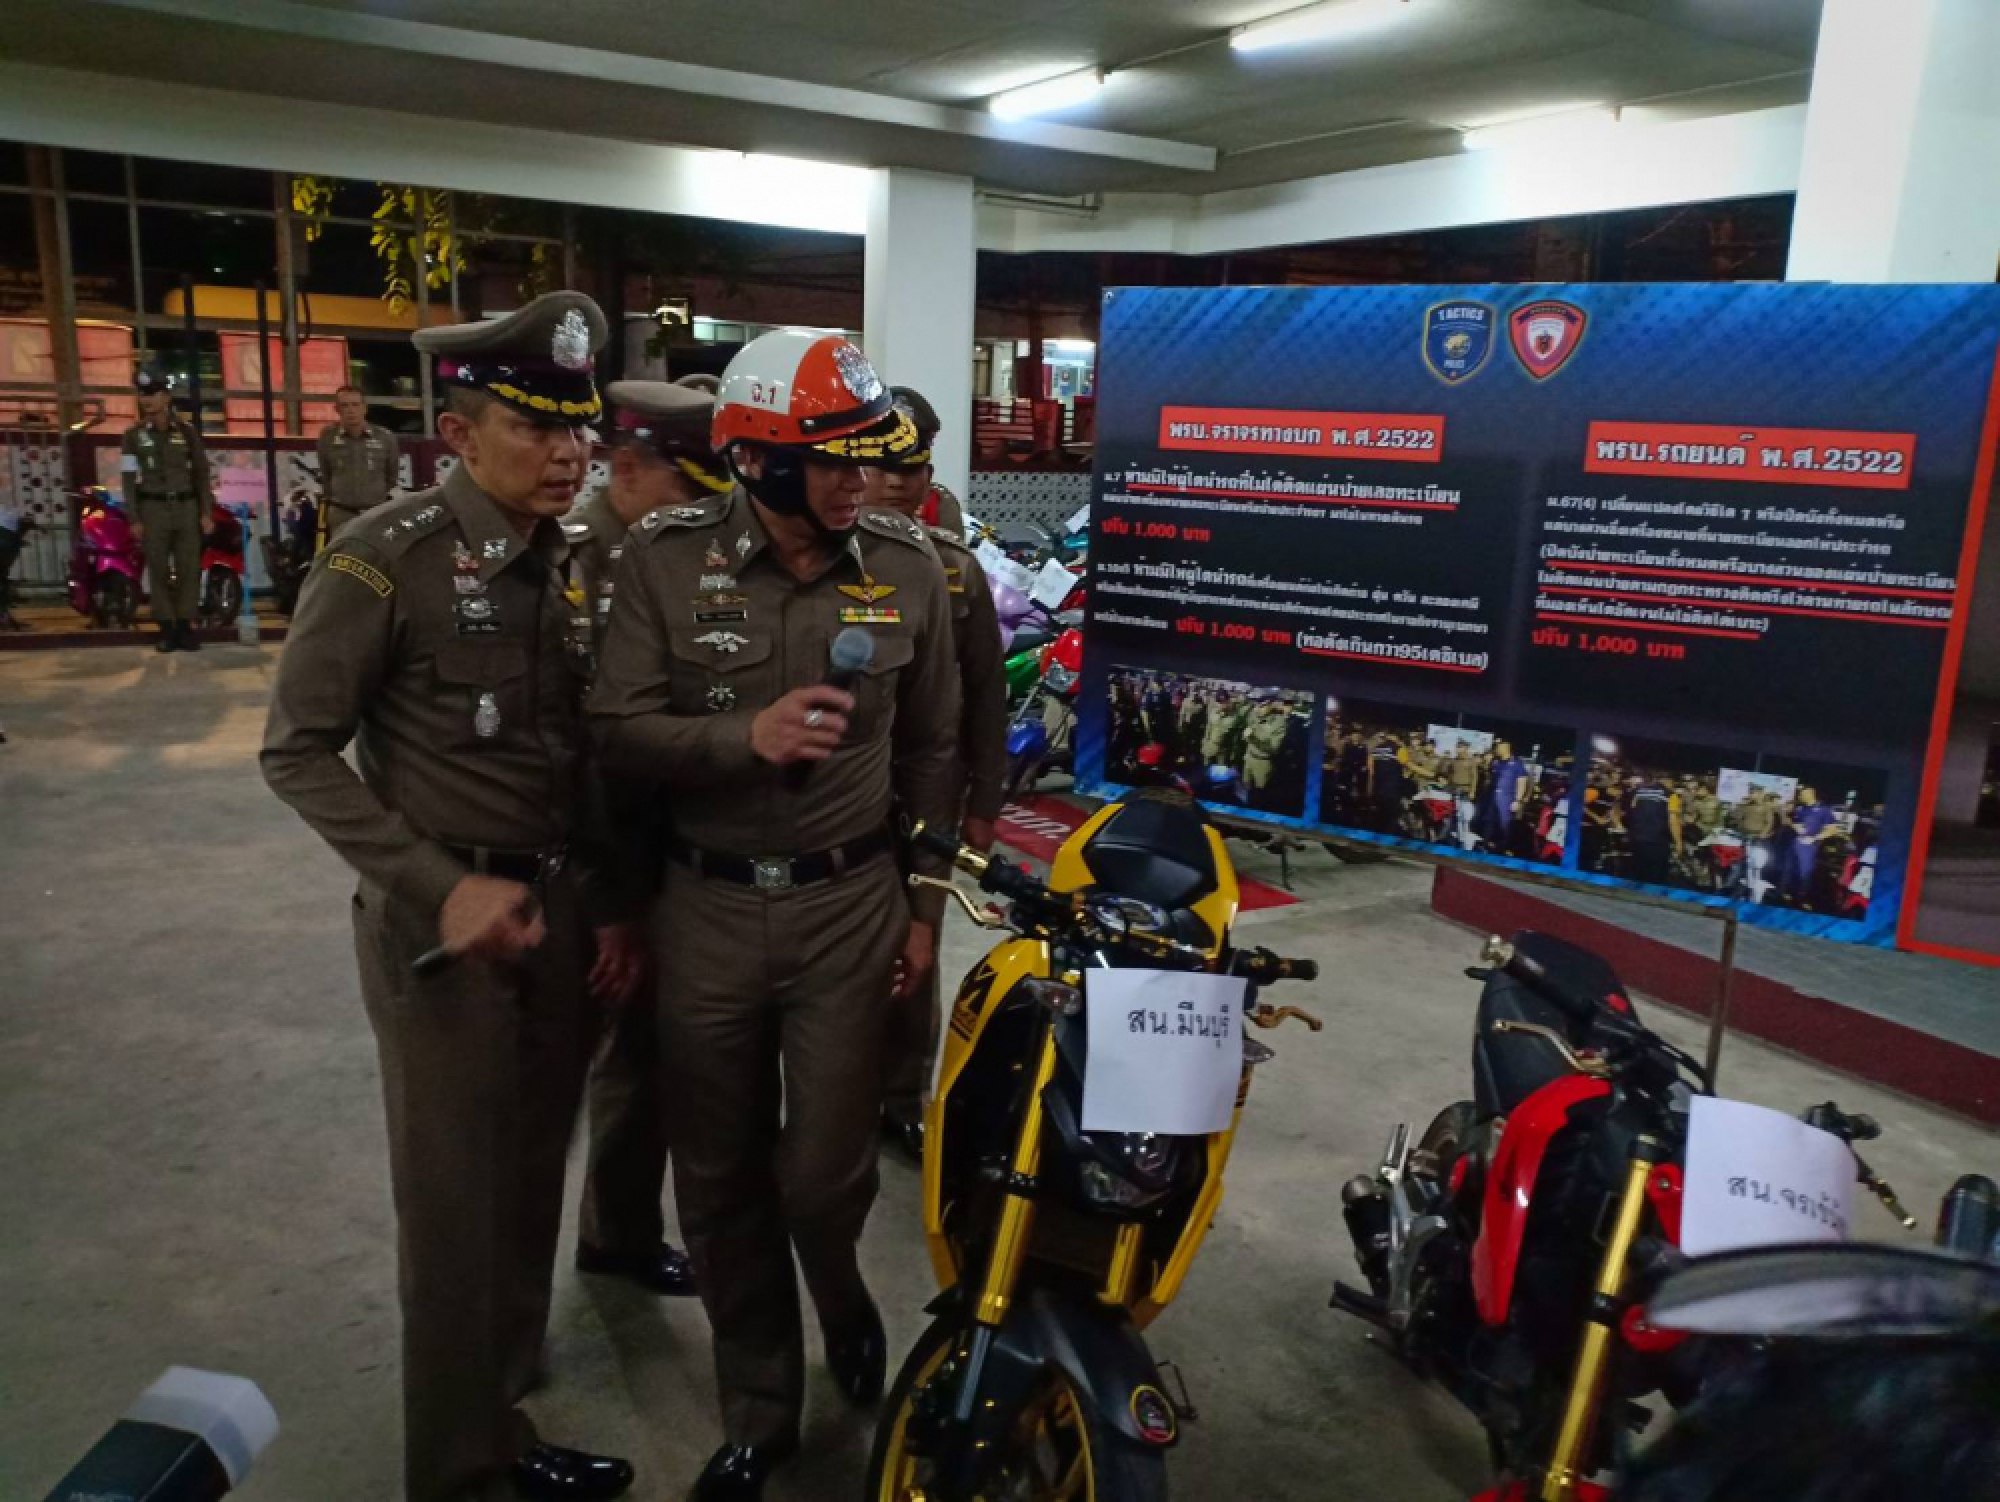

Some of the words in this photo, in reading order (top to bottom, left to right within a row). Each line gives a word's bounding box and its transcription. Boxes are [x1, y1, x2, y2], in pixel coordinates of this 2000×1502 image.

[1331, 428, 1435, 449] พ.ศ.2522
[1761, 447, 1903, 474] พ.ศ.2522
[1579, 633, 1638, 654] 1,000
[1646, 642, 1685, 659] บาท
[1127, 1000, 1230, 1048] สน.มีนบุรี
